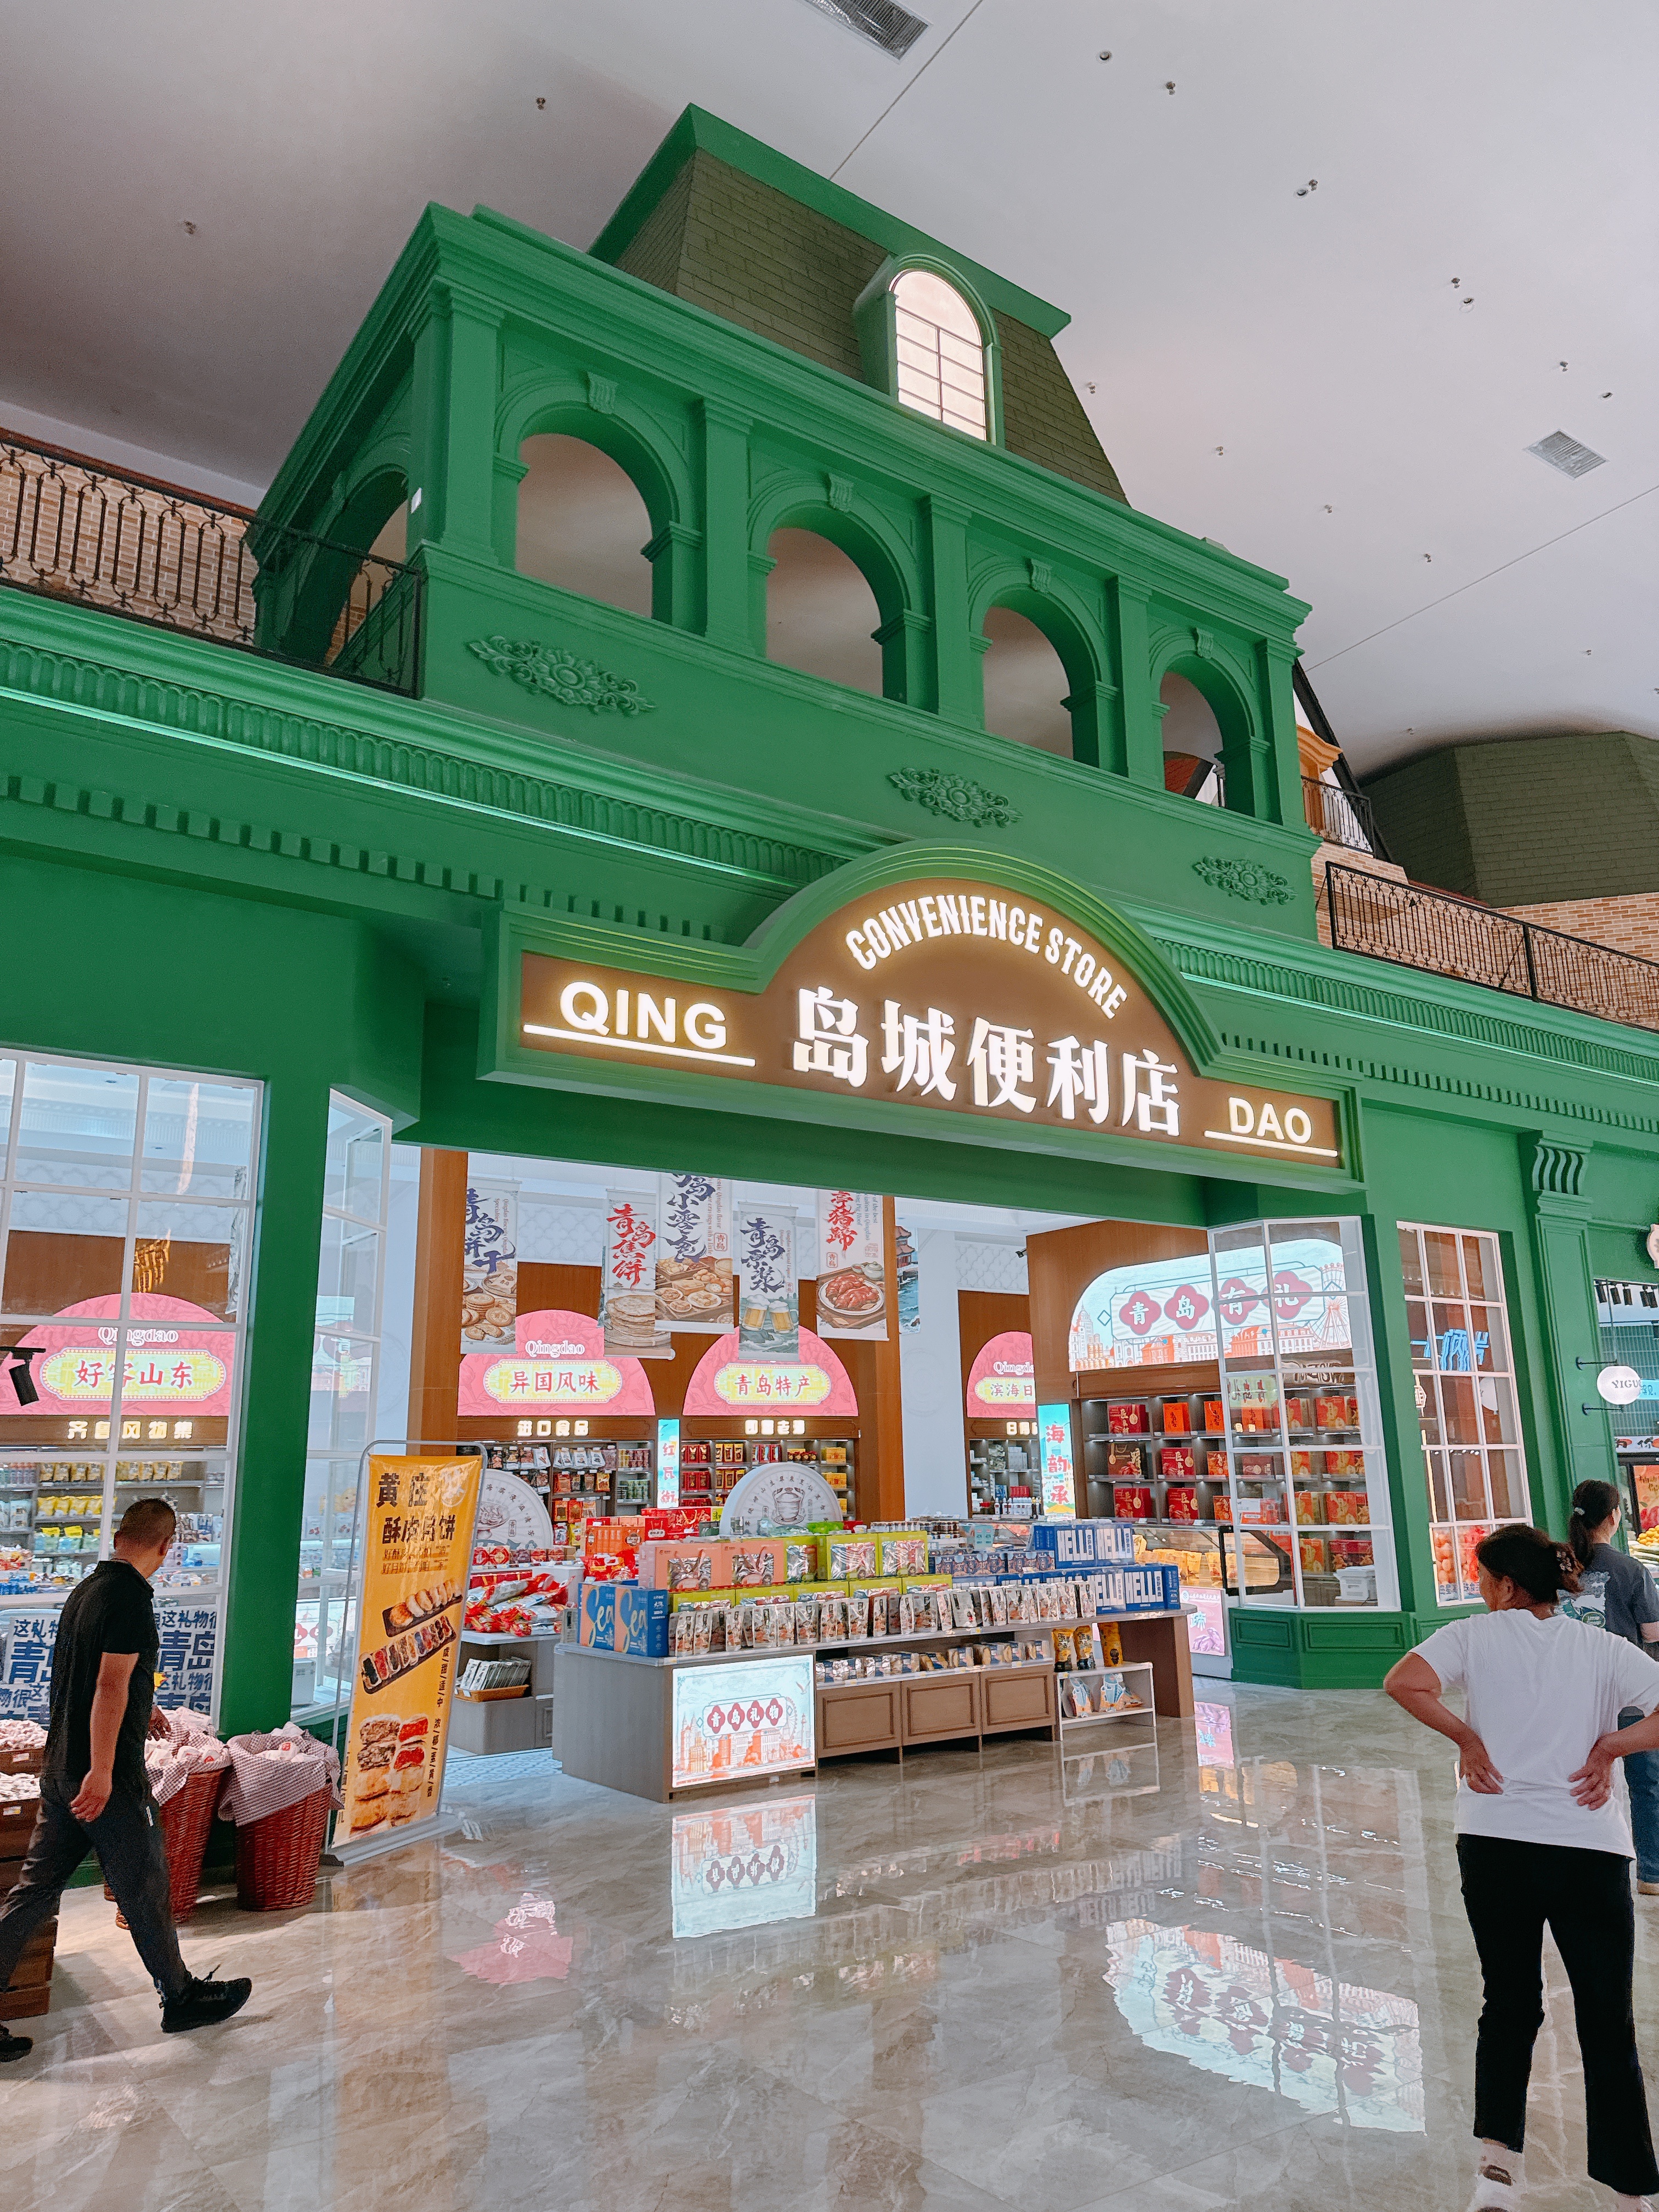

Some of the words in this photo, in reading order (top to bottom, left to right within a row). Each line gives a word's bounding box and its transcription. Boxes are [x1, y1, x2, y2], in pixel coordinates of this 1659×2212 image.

[845, 894, 1045, 970] CONVENIENCE
[1043, 924, 1128, 1019] STORE
[560, 981, 727, 1049] QING
[792, 985, 1182, 1137] 岛城便利店
[1229, 1097, 1312, 1147] DAO
[1129, 1283, 1299, 1325] 青岛有礼
[98, 1327, 179, 1346] Qingdao
[526, 1340, 585, 1358] Qingdao
[74, 1360, 193, 1389] 好客山东
[510, 1371, 601, 1394] 异国风味
[735, 1374, 810, 1396] 青岛特产
[67, 1421, 193, 1440] 齐鲁风物集
[1046, 1424, 1070, 1504] 海韵承
[382, 1514, 455, 1544] 酥皮月饼
[586, 1586, 615, 1647] Sea
[620, 1589, 648, 1654] Sea
[710, 1703, 784, 1728] 青岛礼物
